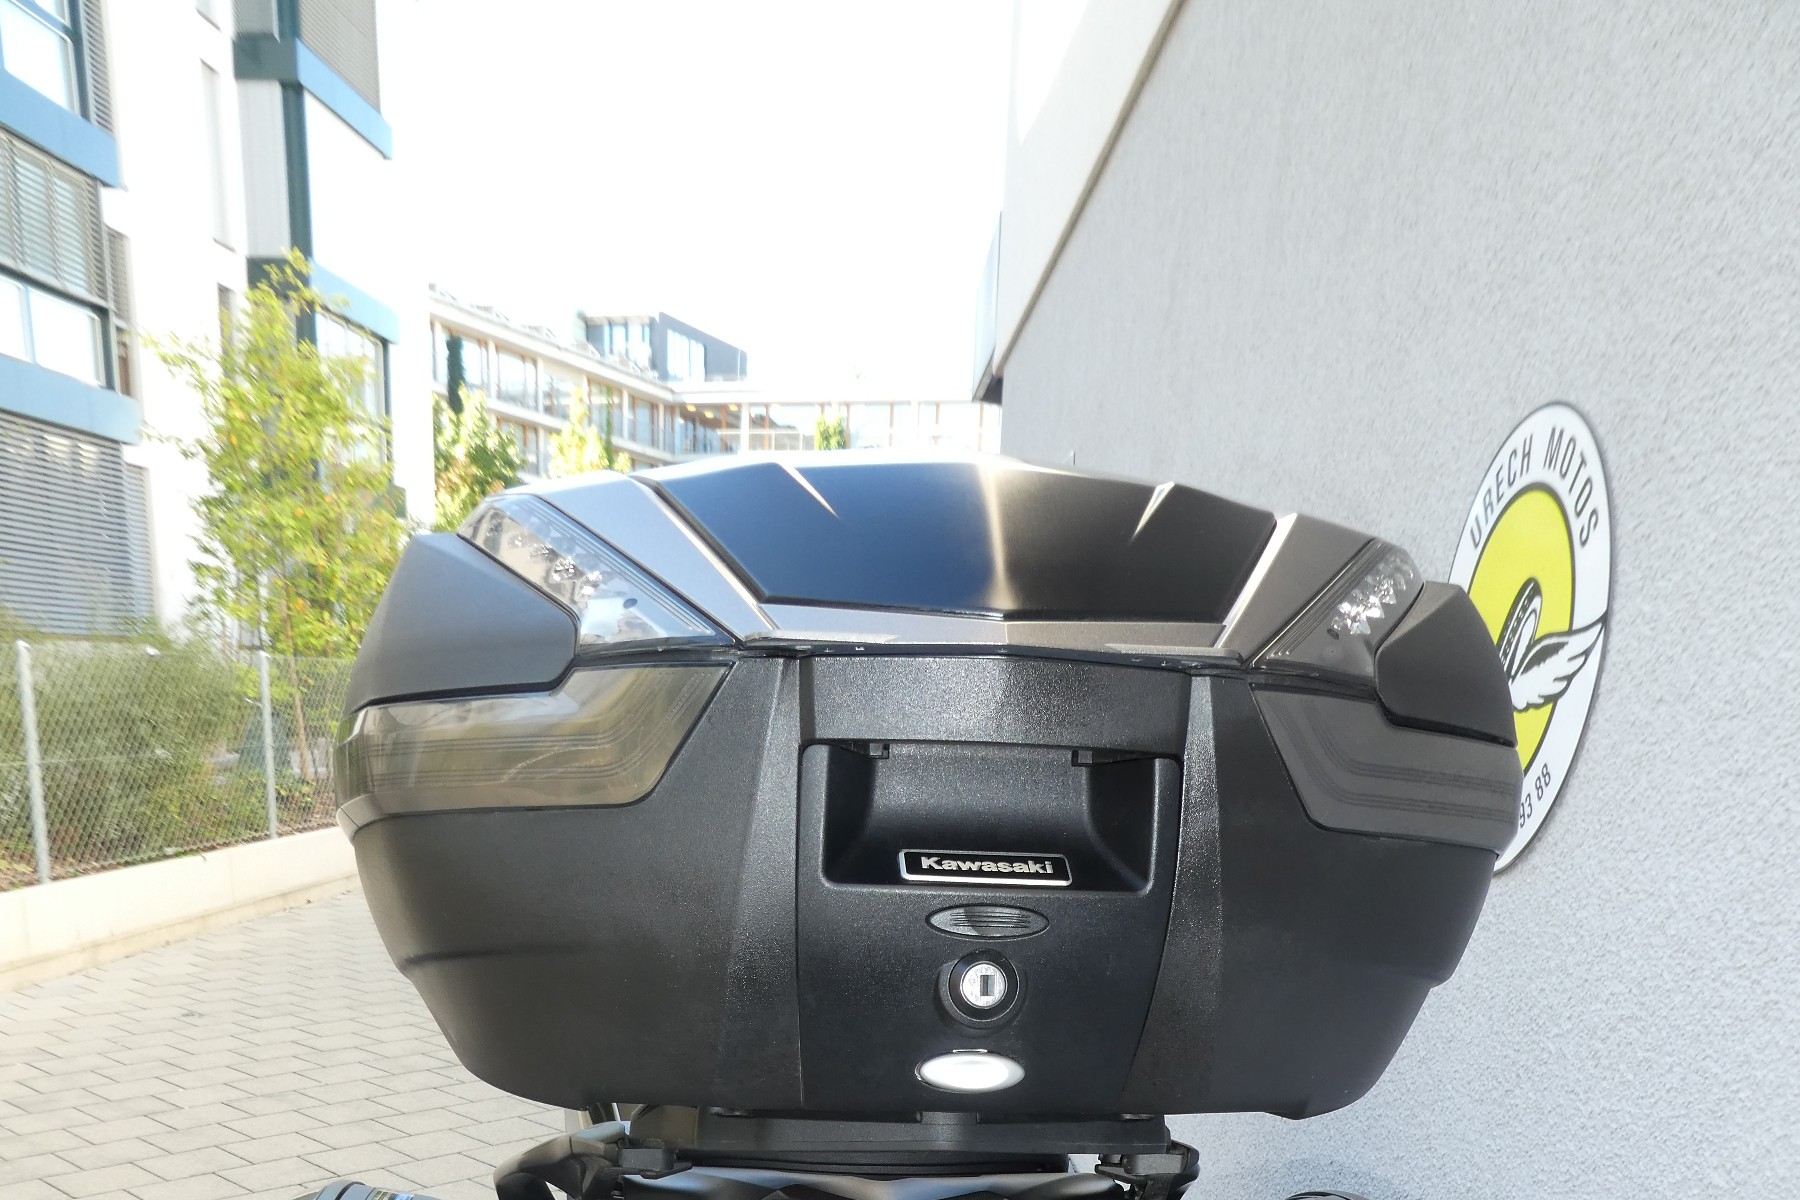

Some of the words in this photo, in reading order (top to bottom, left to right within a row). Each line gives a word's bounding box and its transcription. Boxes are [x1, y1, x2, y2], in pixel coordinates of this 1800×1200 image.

[1470, 433, 1533, 550] URECH
[1543, 426, 1599, 548] MOTOS
[1535, 763, 1551, 801] 88
[920, 856, 1054, 874] Kawasaki
